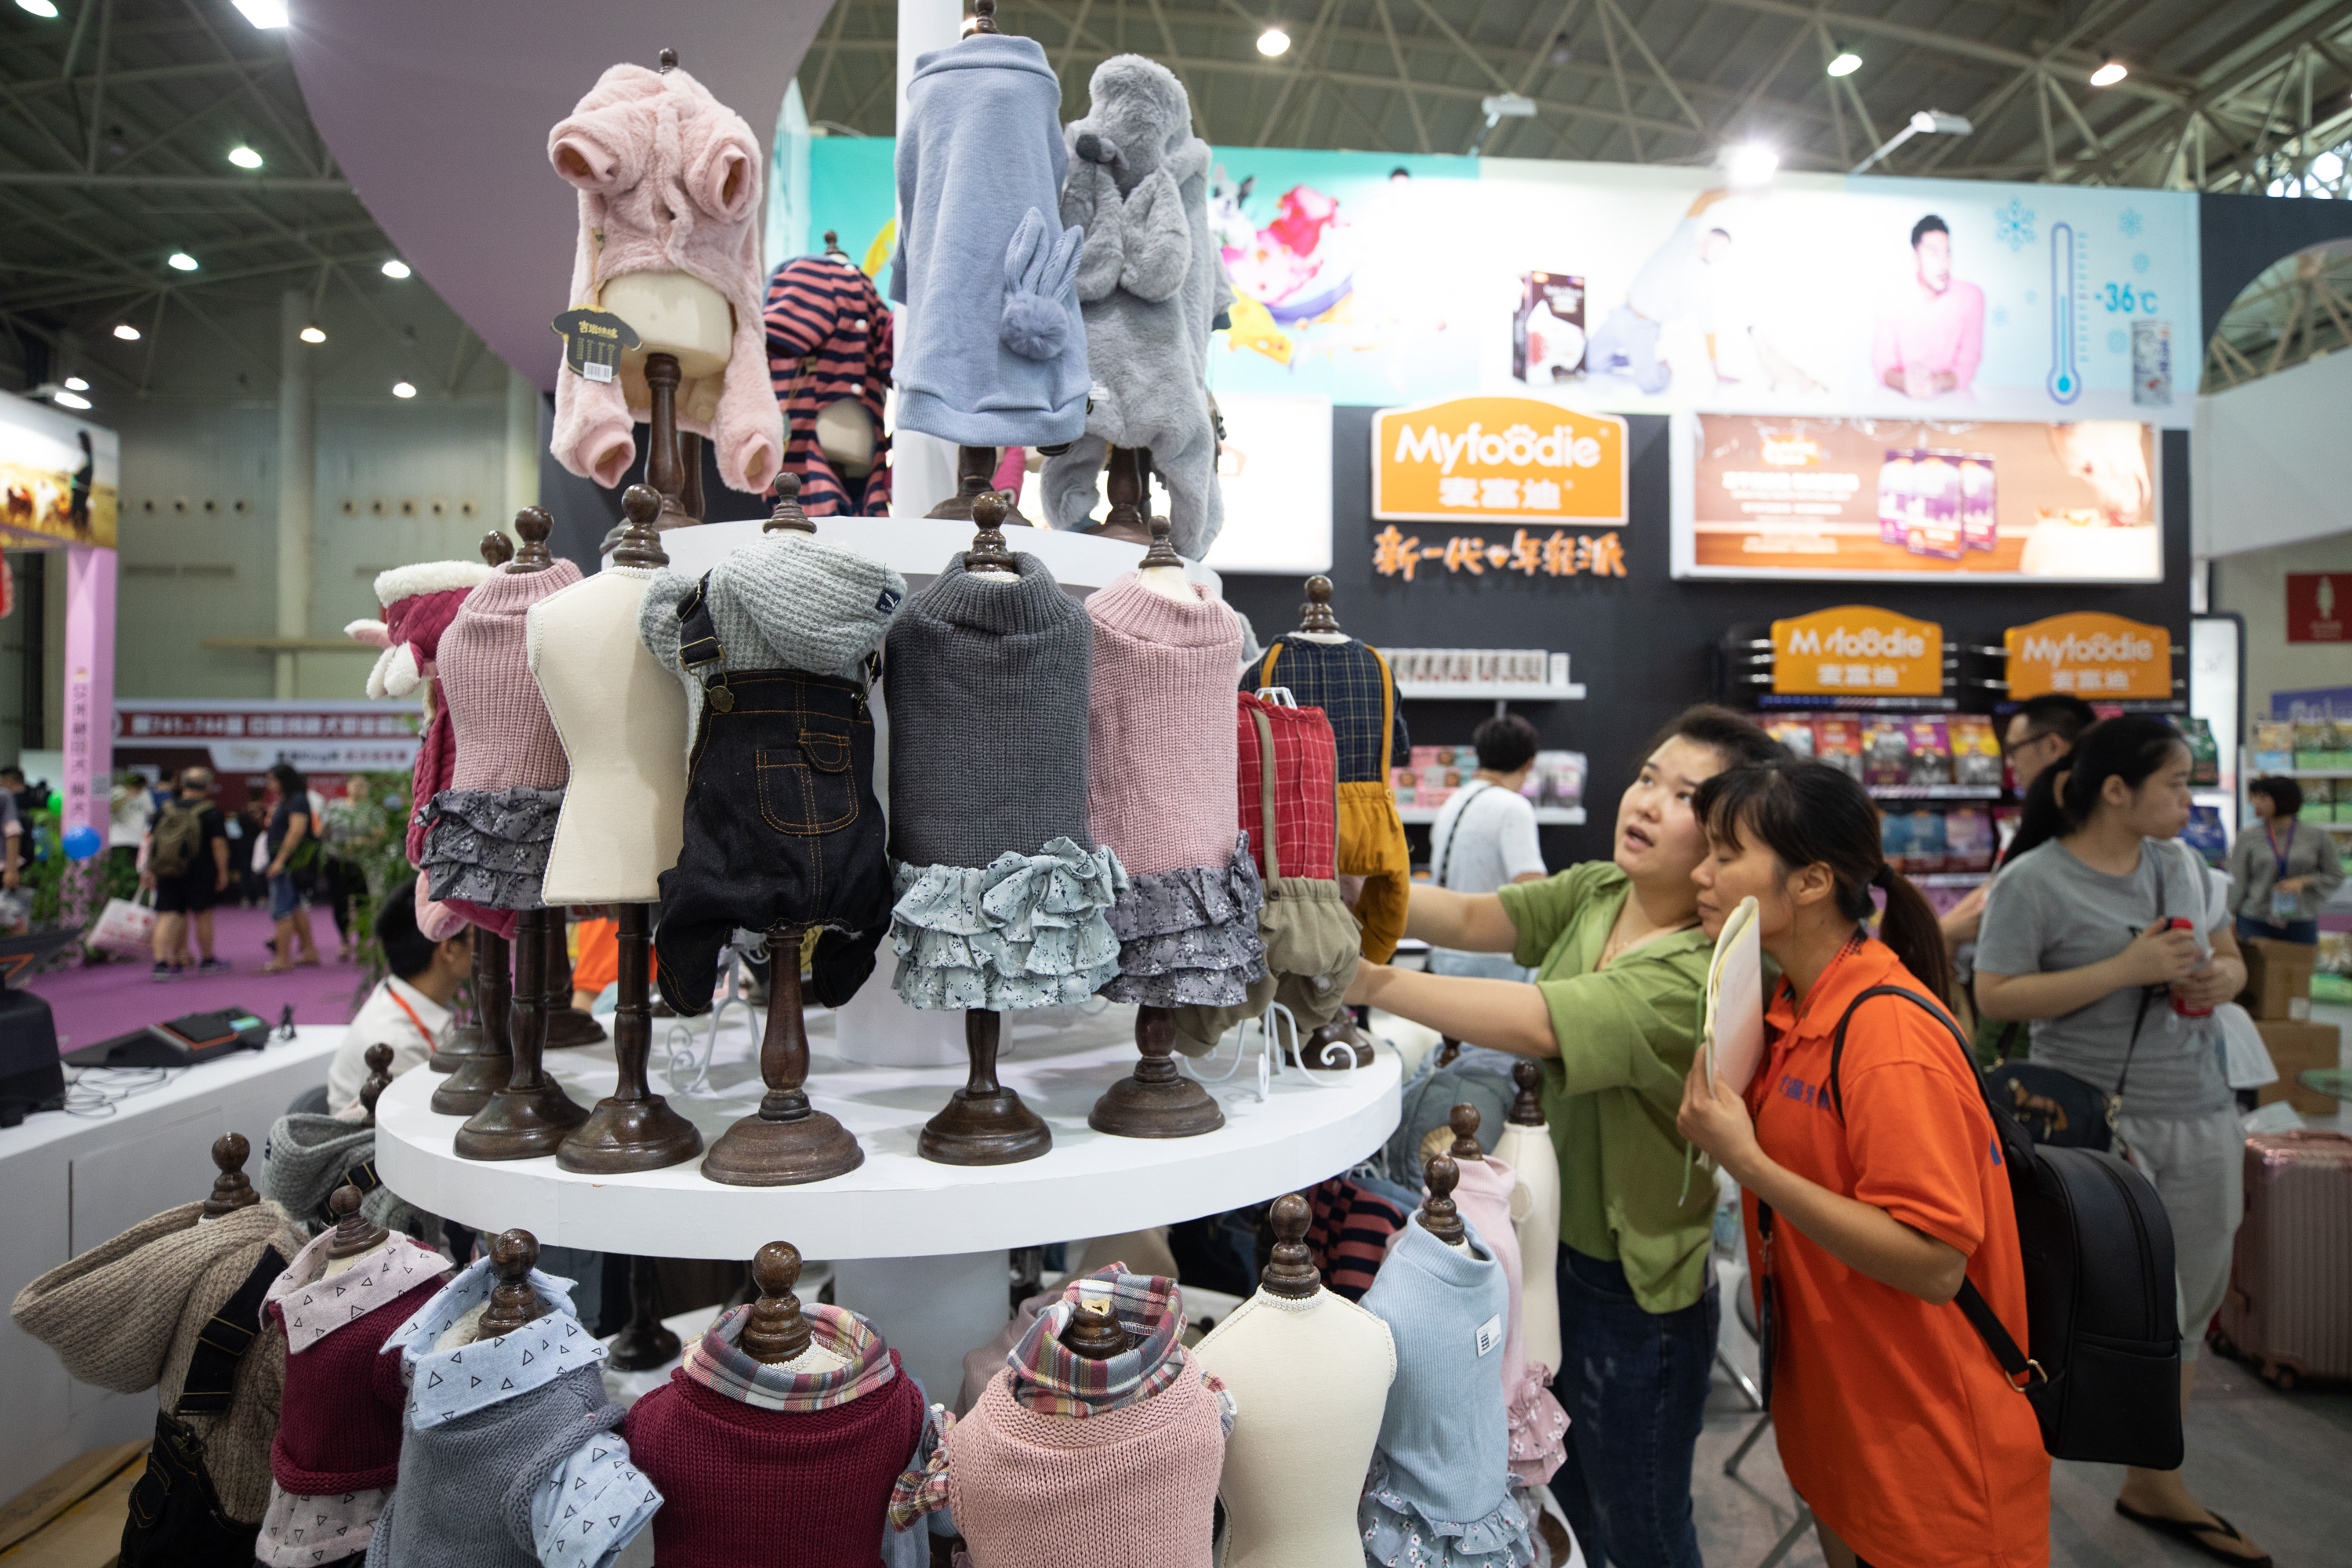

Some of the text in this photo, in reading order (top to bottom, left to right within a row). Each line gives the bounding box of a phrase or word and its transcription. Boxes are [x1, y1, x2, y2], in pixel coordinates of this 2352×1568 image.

[1394, 423, 1602, 475] Myfoodie
[1439, 477, 1562, 510] 麦富迪
[2022, 632, 2153, 667] Myfoodie
[1817, 663, 1898, 687] 麦富迪
